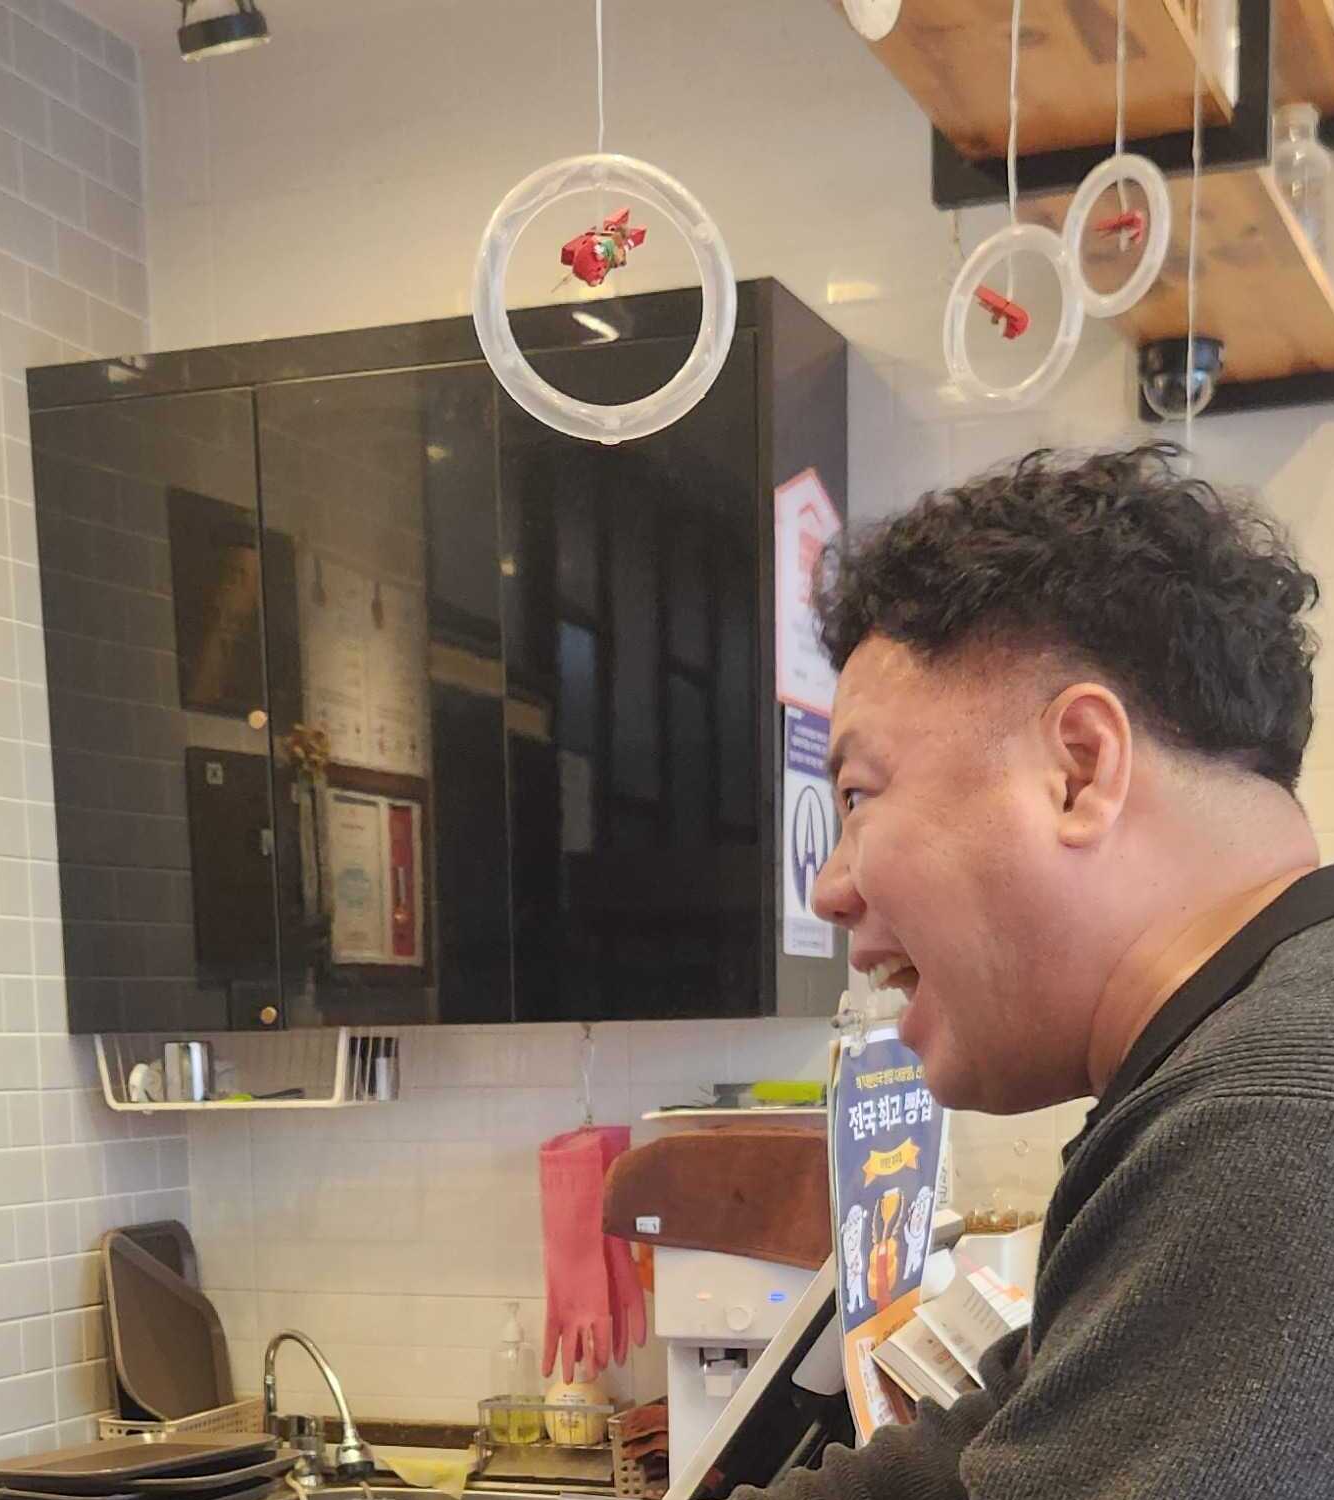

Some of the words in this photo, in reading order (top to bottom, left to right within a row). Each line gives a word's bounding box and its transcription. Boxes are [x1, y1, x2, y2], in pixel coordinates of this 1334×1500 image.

[848, 1099, 878, 1142] 전국
[878, 1092, 903, 1133] 최고
[903, 1087, 934, 1125] 빵집
